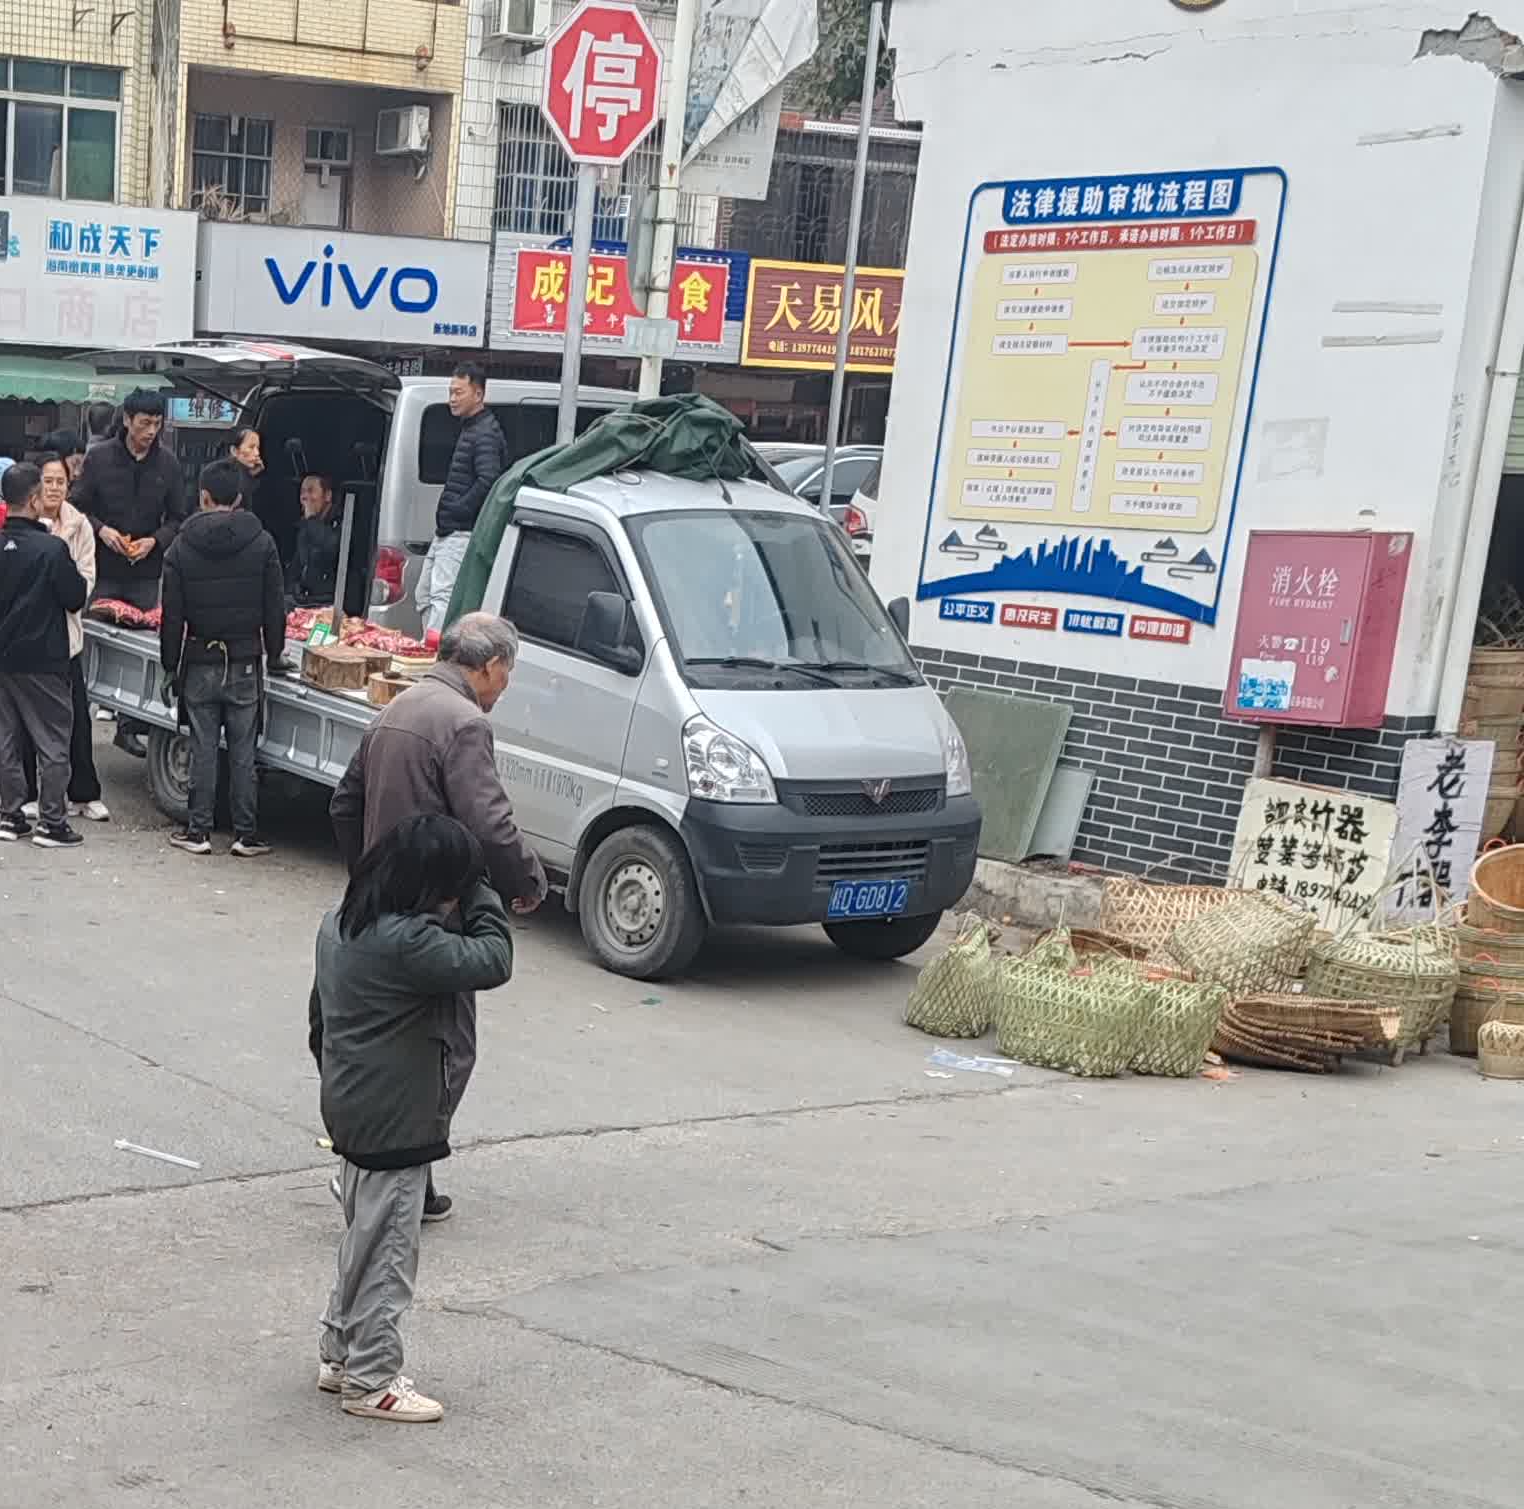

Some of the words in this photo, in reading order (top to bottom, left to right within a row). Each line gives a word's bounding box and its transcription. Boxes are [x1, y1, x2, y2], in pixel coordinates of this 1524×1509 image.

[562, 30, 643, 142] 停
[1009, 178, 1235, 219] 法律援助审批流程图
[48, 218, 162, 258] 和成天下
[264, 243, 438, 314] vivo
[531, 259, 712, 314] 成记食
[1270, 565, 1340, 597] 消火栓
[943, 602, 989, 619] 公平正义
[1003, 606, 1053, 625] 惠及民生
[1258, 633, 1282, 650] 火警
[1299, 636, 1331, 655] 119
[1305, 654, 1326, 666] 119
